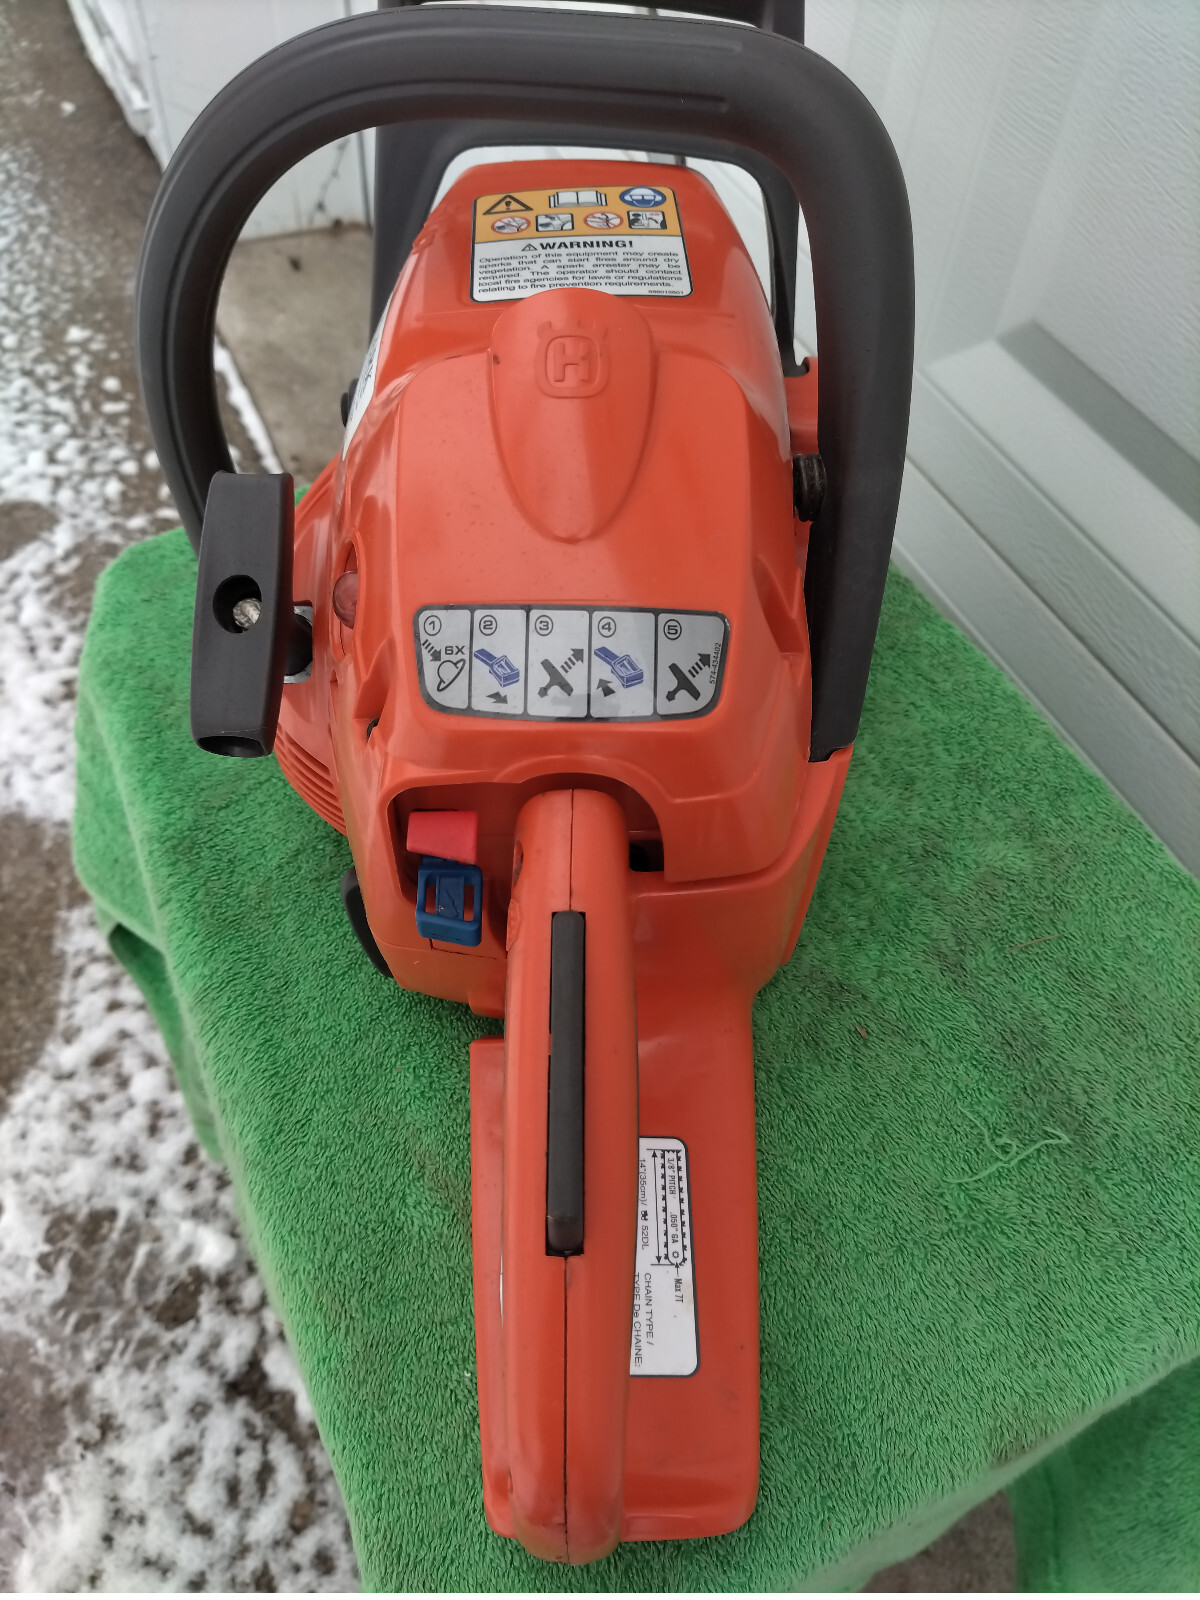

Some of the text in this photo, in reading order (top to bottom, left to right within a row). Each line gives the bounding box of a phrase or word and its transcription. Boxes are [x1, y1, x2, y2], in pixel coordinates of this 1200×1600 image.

[540, 241, 633, 250] WARNING!
[479, 266, 533, 274] vegetation.
[479, 273, 522, 281] required.
[445, 646, 465, 655] 6X
[671, 1233, 678, 1244] GA
[674, 1278, 682, 1292] Max
[634, 1304, 640, 1318] De
